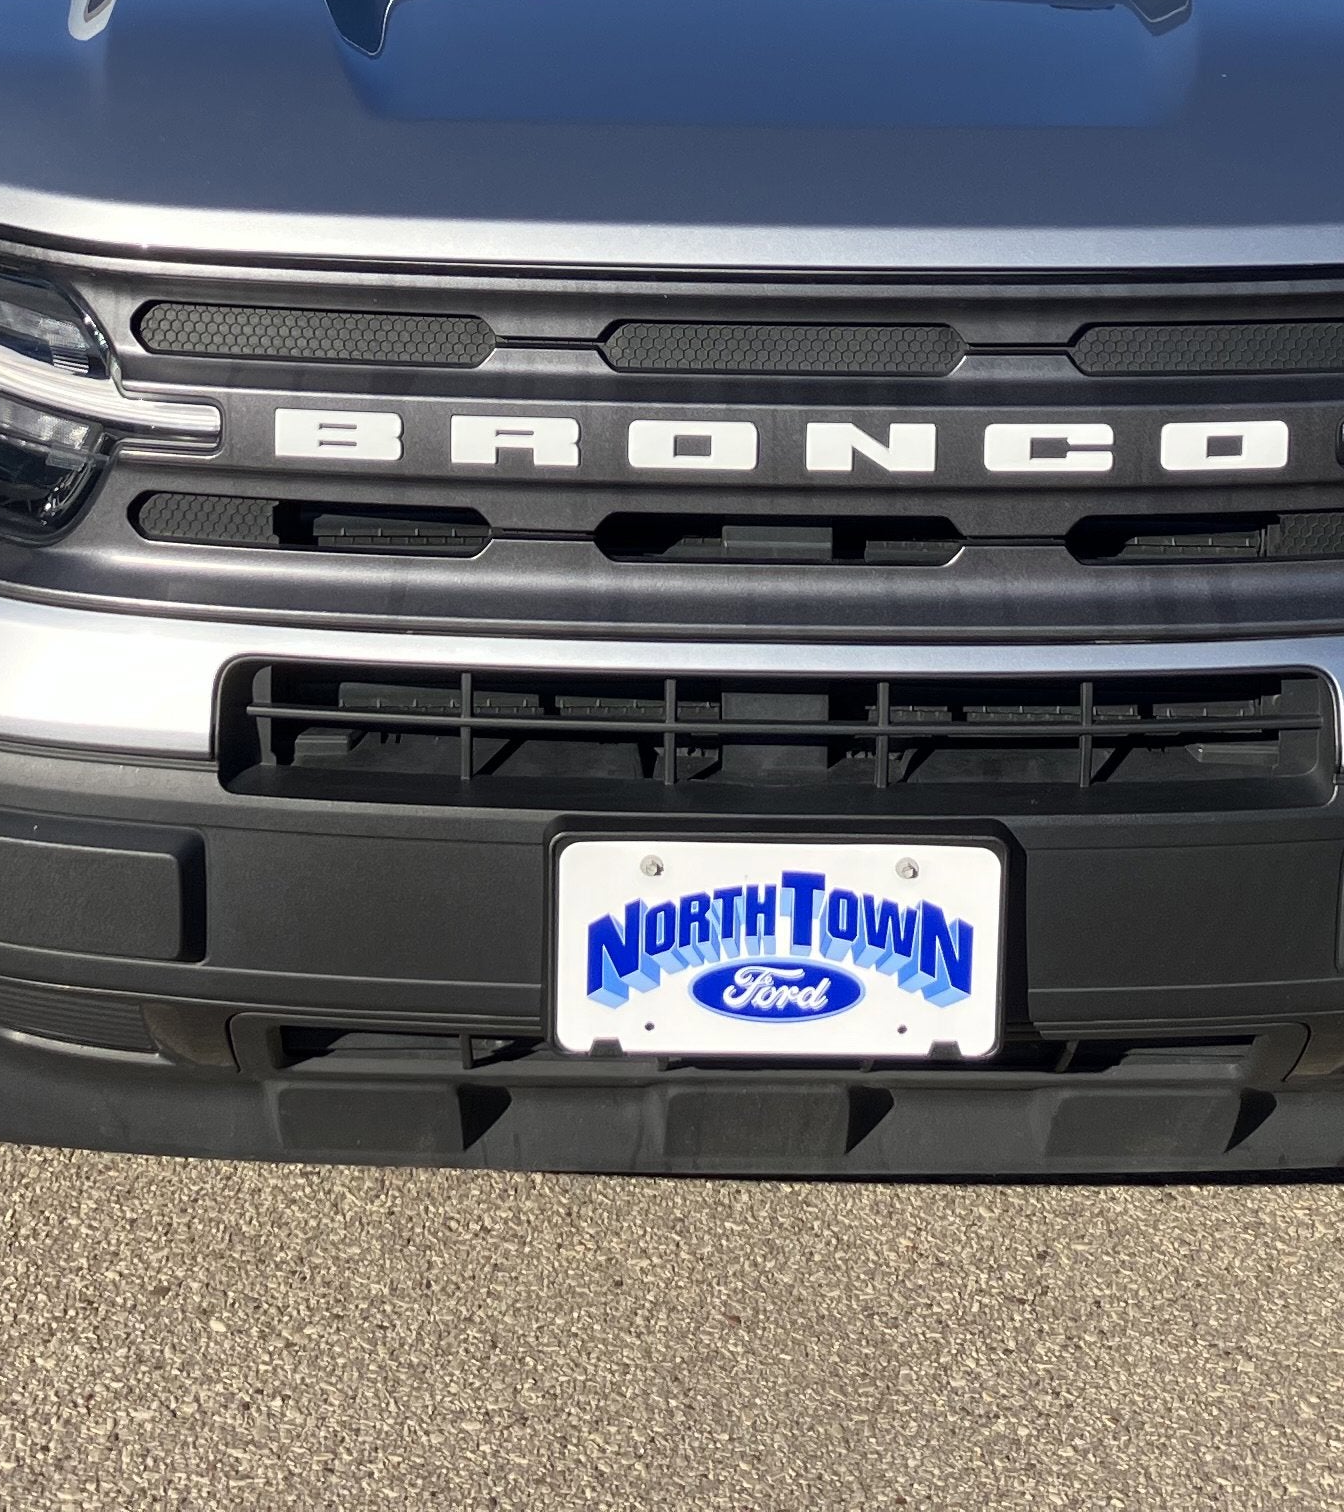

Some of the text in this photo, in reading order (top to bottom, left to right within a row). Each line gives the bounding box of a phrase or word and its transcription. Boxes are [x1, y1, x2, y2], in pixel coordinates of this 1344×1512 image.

[274, 406, 1291, 472] BRONCO
[586, 869, 974, 1006] NORTHTOWN
[721, 964, 830, 1010] Ford
